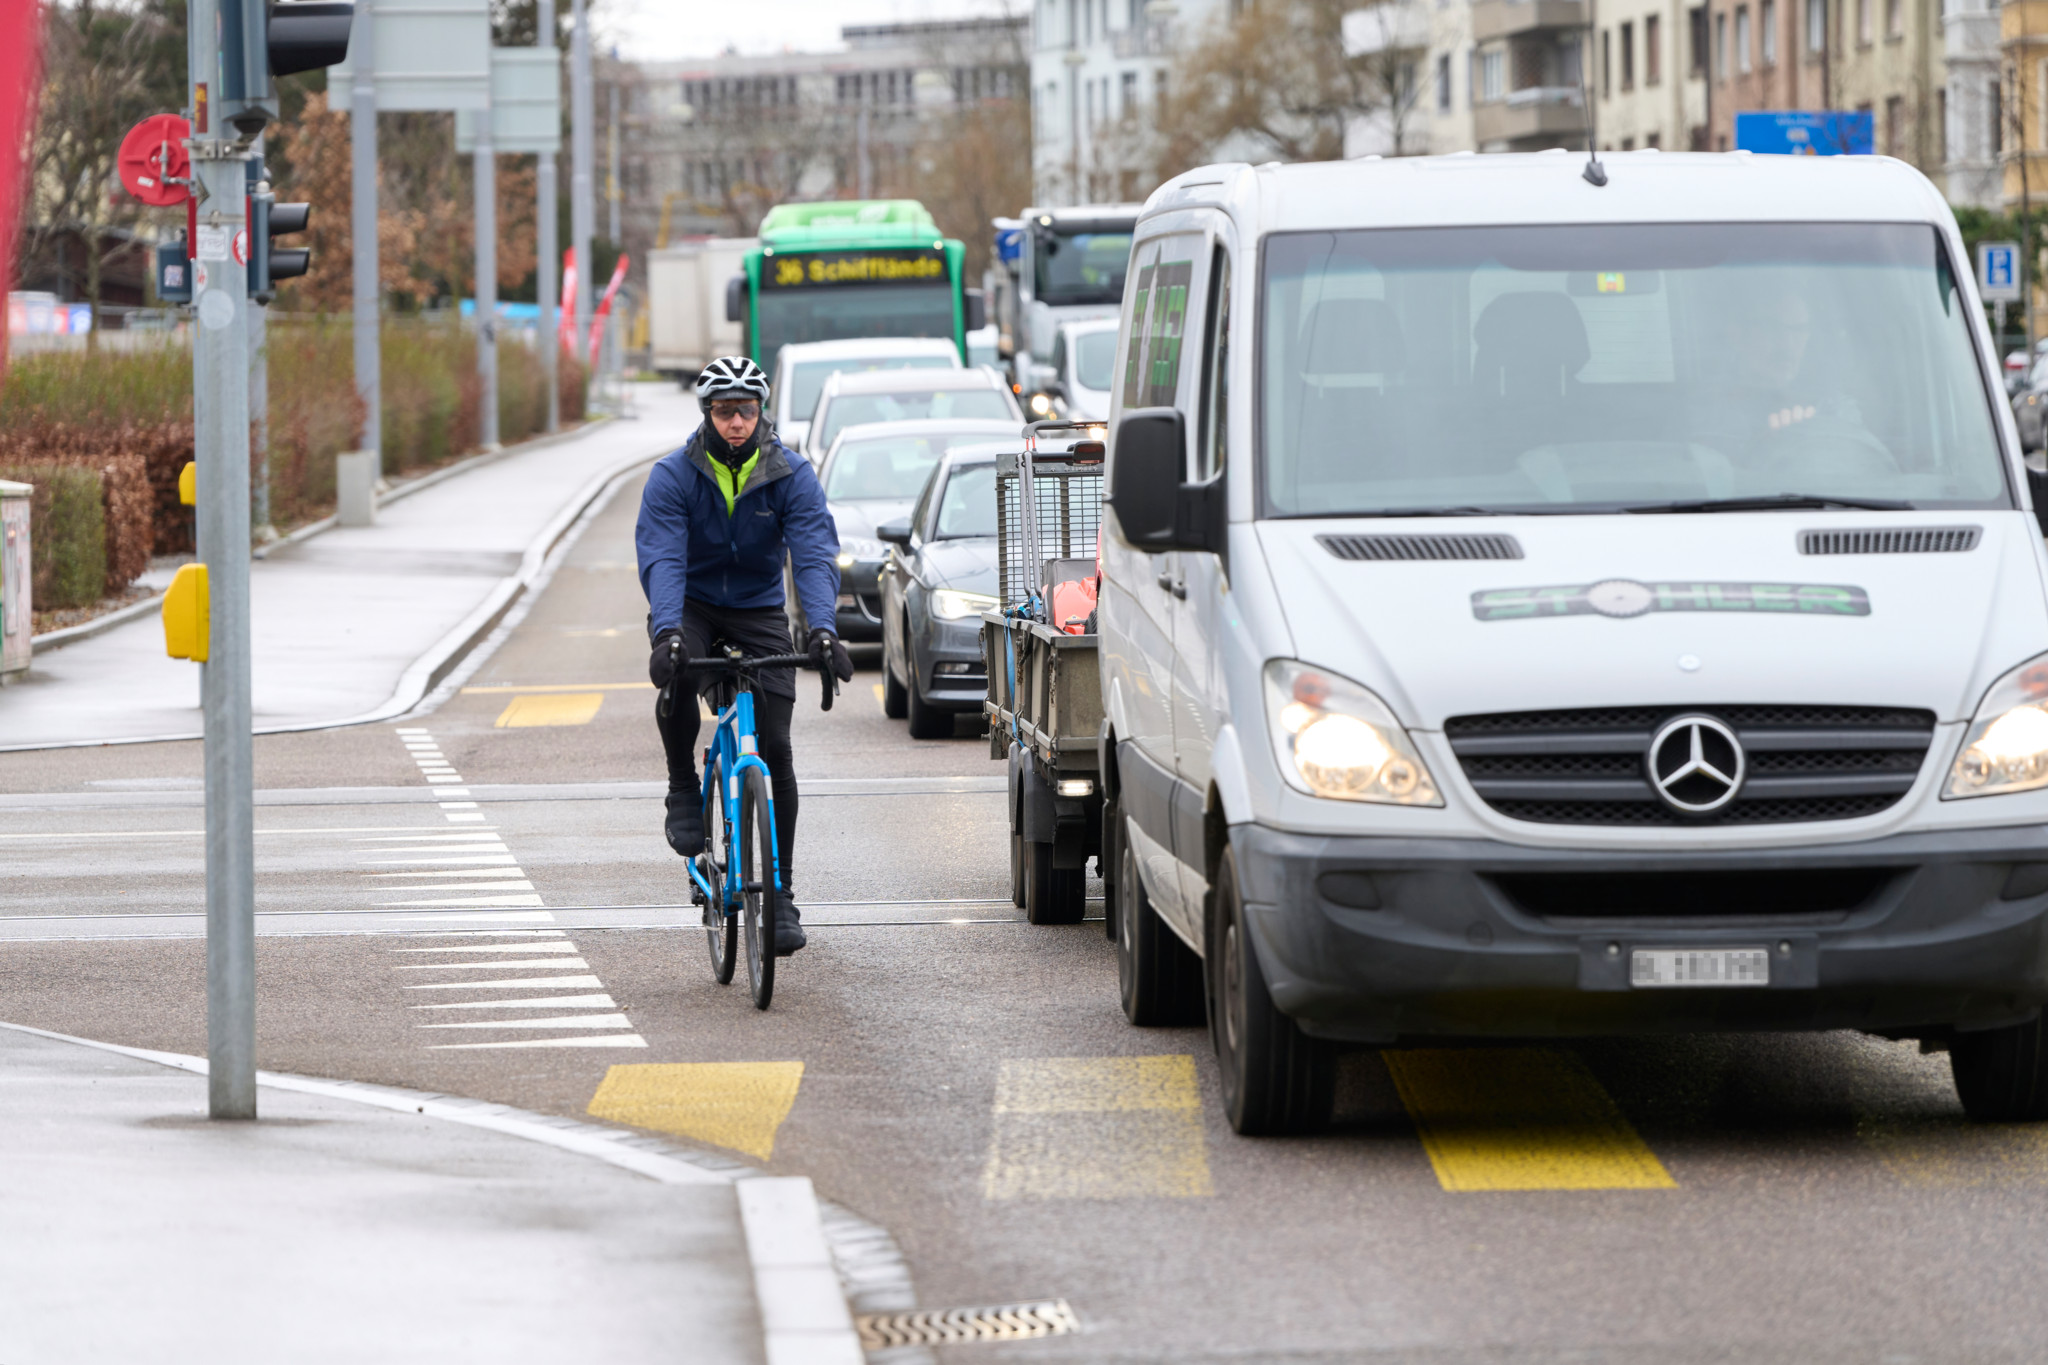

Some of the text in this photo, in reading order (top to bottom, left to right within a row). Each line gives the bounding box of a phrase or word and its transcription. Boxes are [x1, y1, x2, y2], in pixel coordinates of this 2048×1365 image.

[775, 256, 943, 285] 36 Schifflände
[1992, 250, 2008, 268] P
